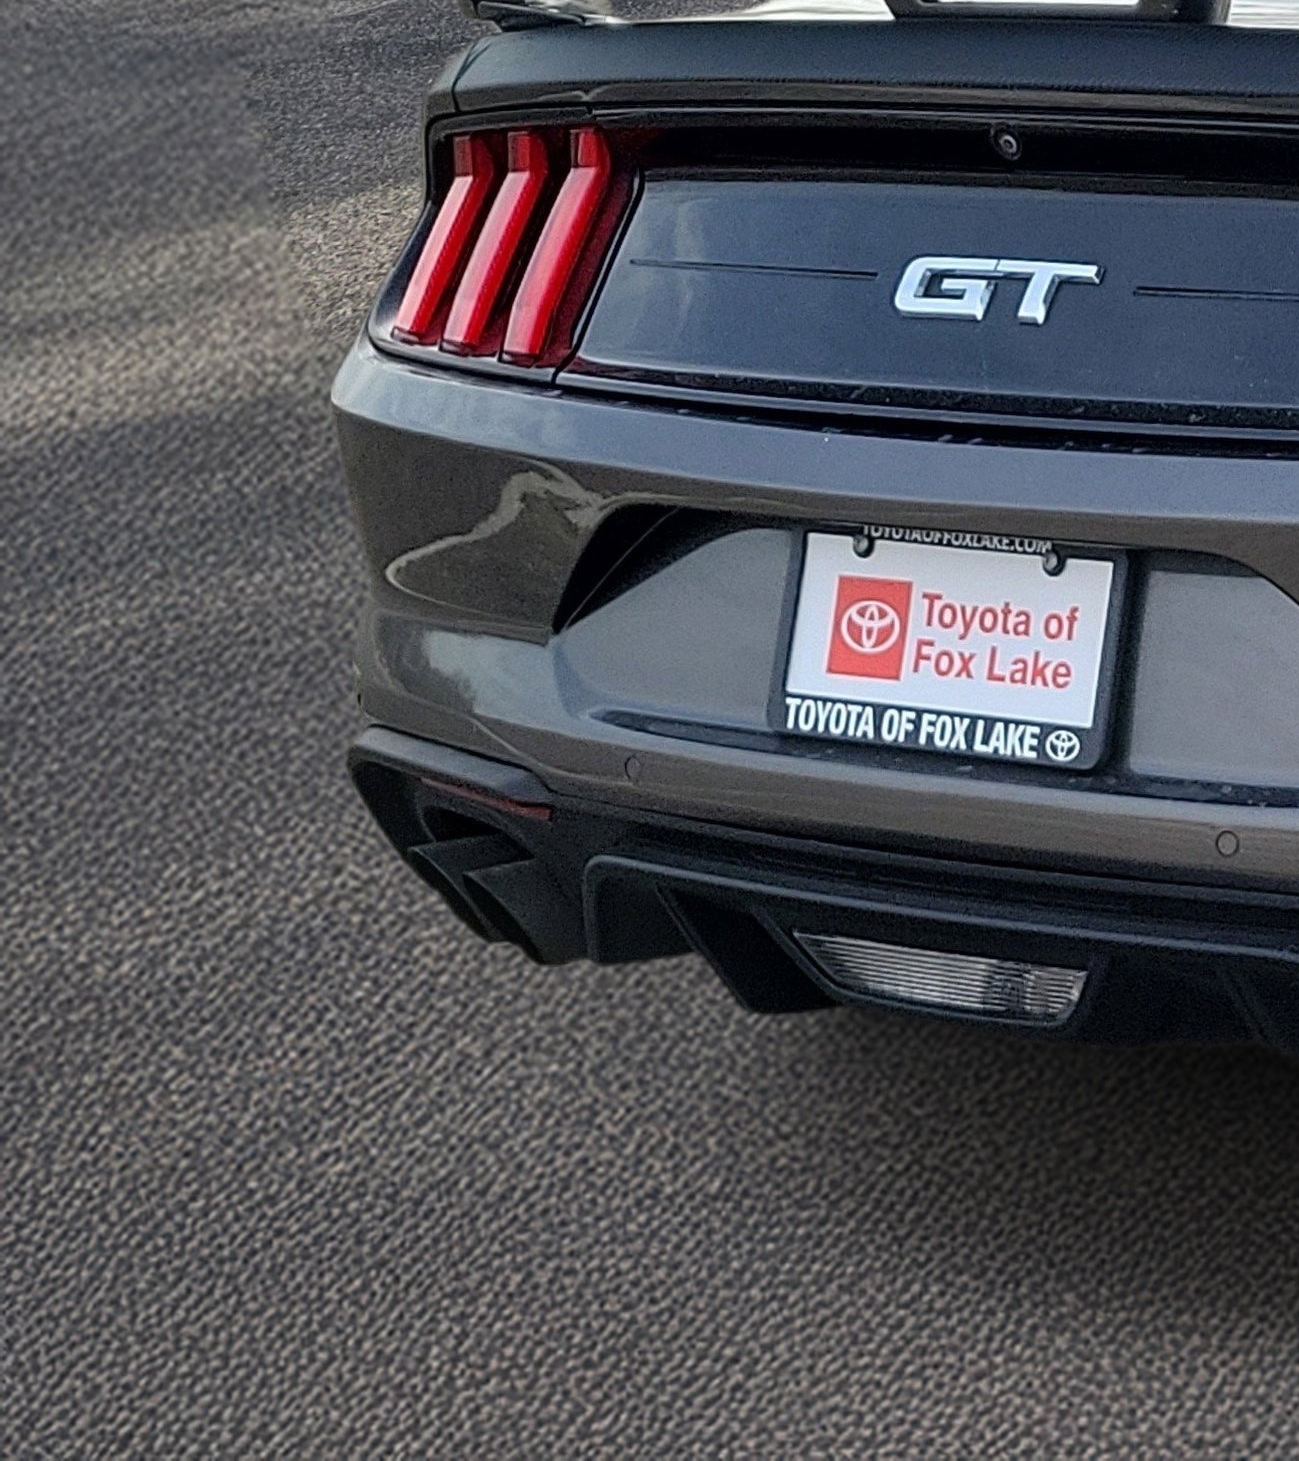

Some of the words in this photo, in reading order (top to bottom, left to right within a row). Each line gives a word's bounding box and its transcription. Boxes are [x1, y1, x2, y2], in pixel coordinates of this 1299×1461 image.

[894, 255, 1106, 325] GT
[921, 591, 1032, 641] Toyota
[1043, 605, 1080, 642] of
[912, 639, 976, 680] Fox
[986, 645, 1073, 690] Lake
[785, 697, 876, 741] TOYOTA
[881, 708, 915, 743] OF
[918, 714, 971, 751] FOX
[973, 719, 1041, 759] LAKE
